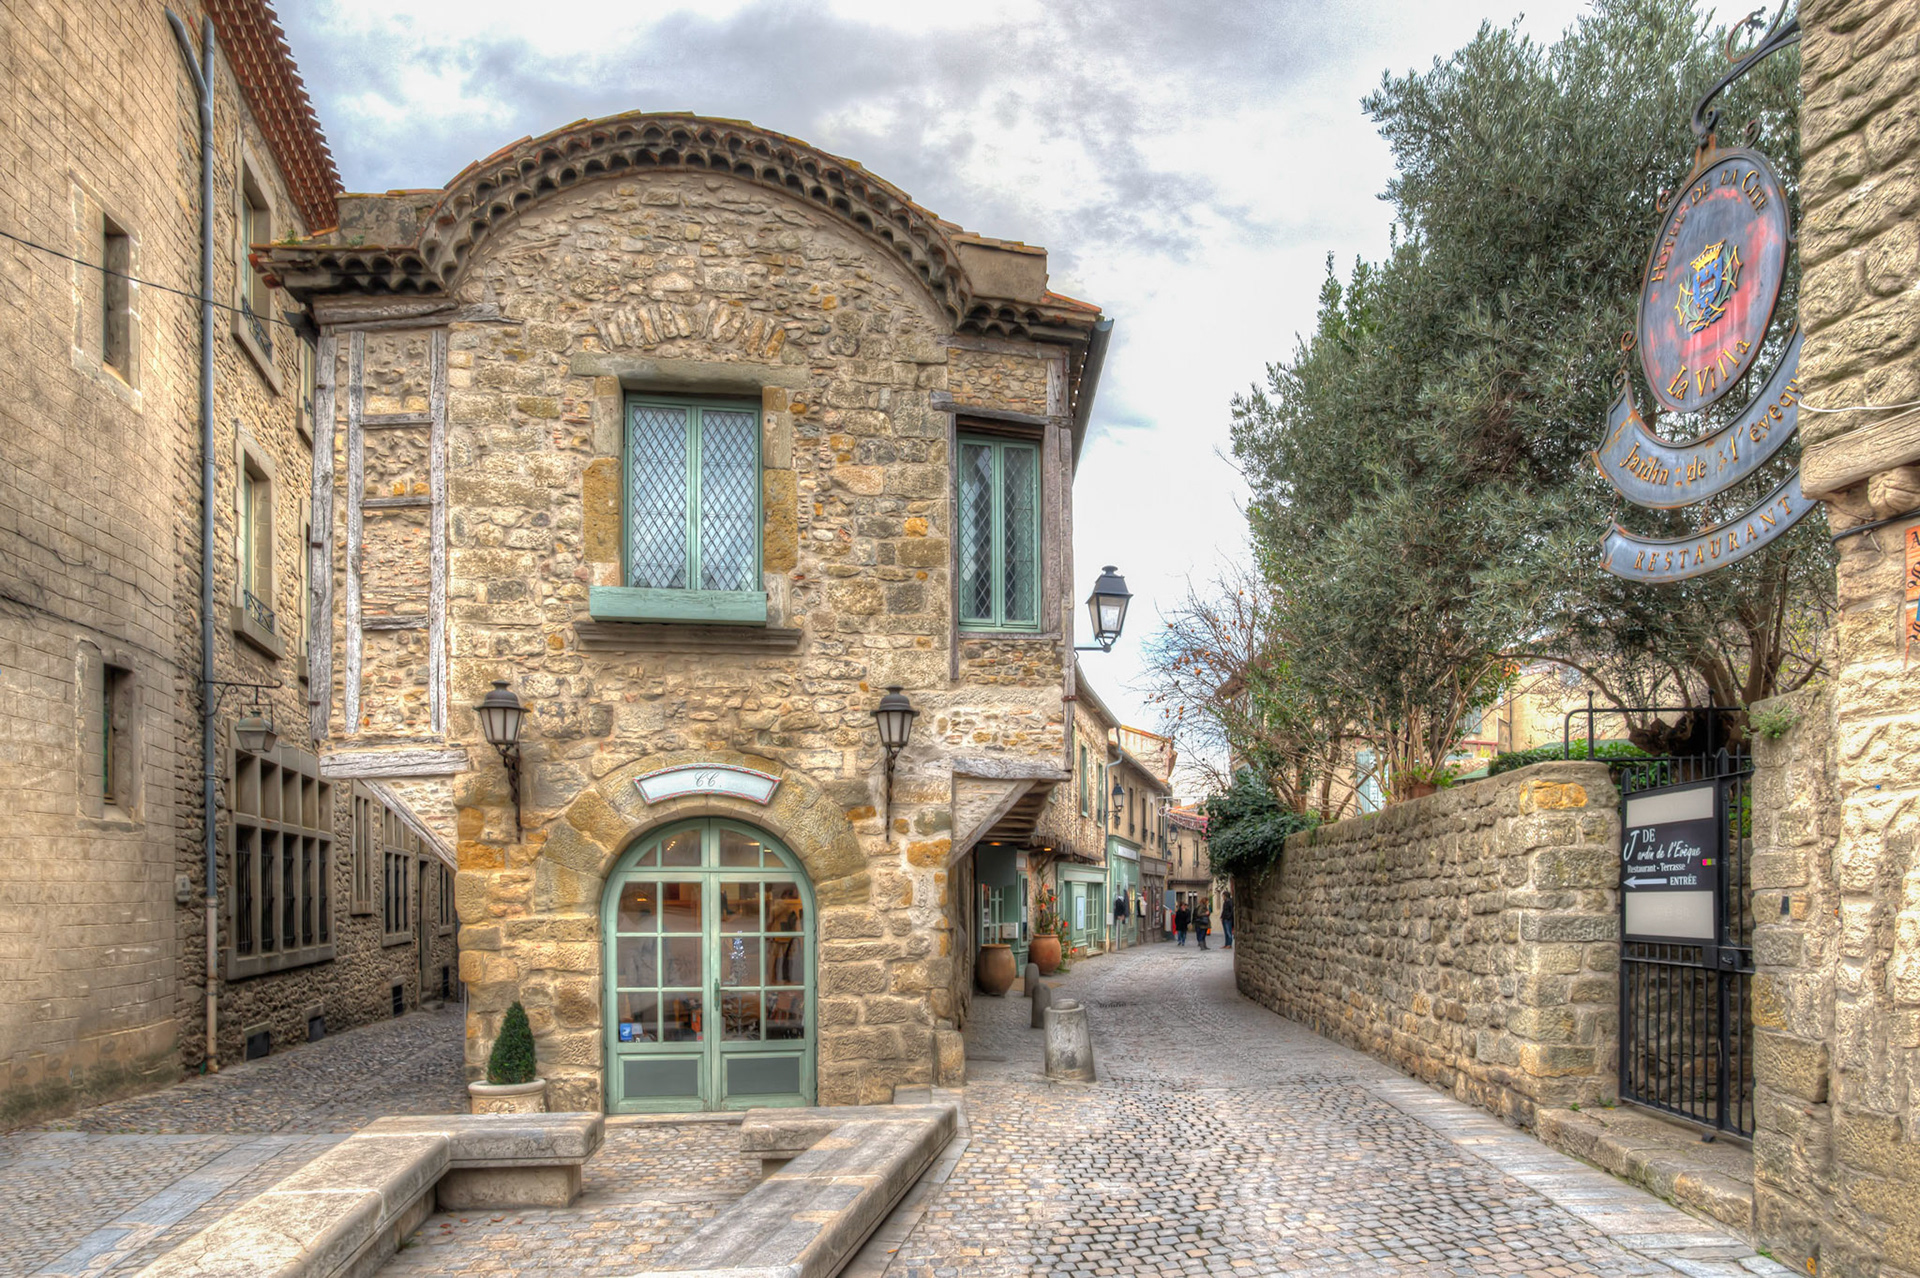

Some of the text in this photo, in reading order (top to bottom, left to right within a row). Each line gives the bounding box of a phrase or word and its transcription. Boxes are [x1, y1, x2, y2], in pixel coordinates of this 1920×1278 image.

[1666, 339, 1751, 400] La Villa
[1619, 441, 1670, 486] Jardin
[1686, 454, 1707, 482] de
[1633, 494, 1793, 571] RESTAURANT
[1656, 843, 1665, 859] de
[1627, 865, 1657, 873] Restaurant
[1660, 862, 1686, 872] Terrasse
[1669, 874, 1697, 886] ENTRÉE
